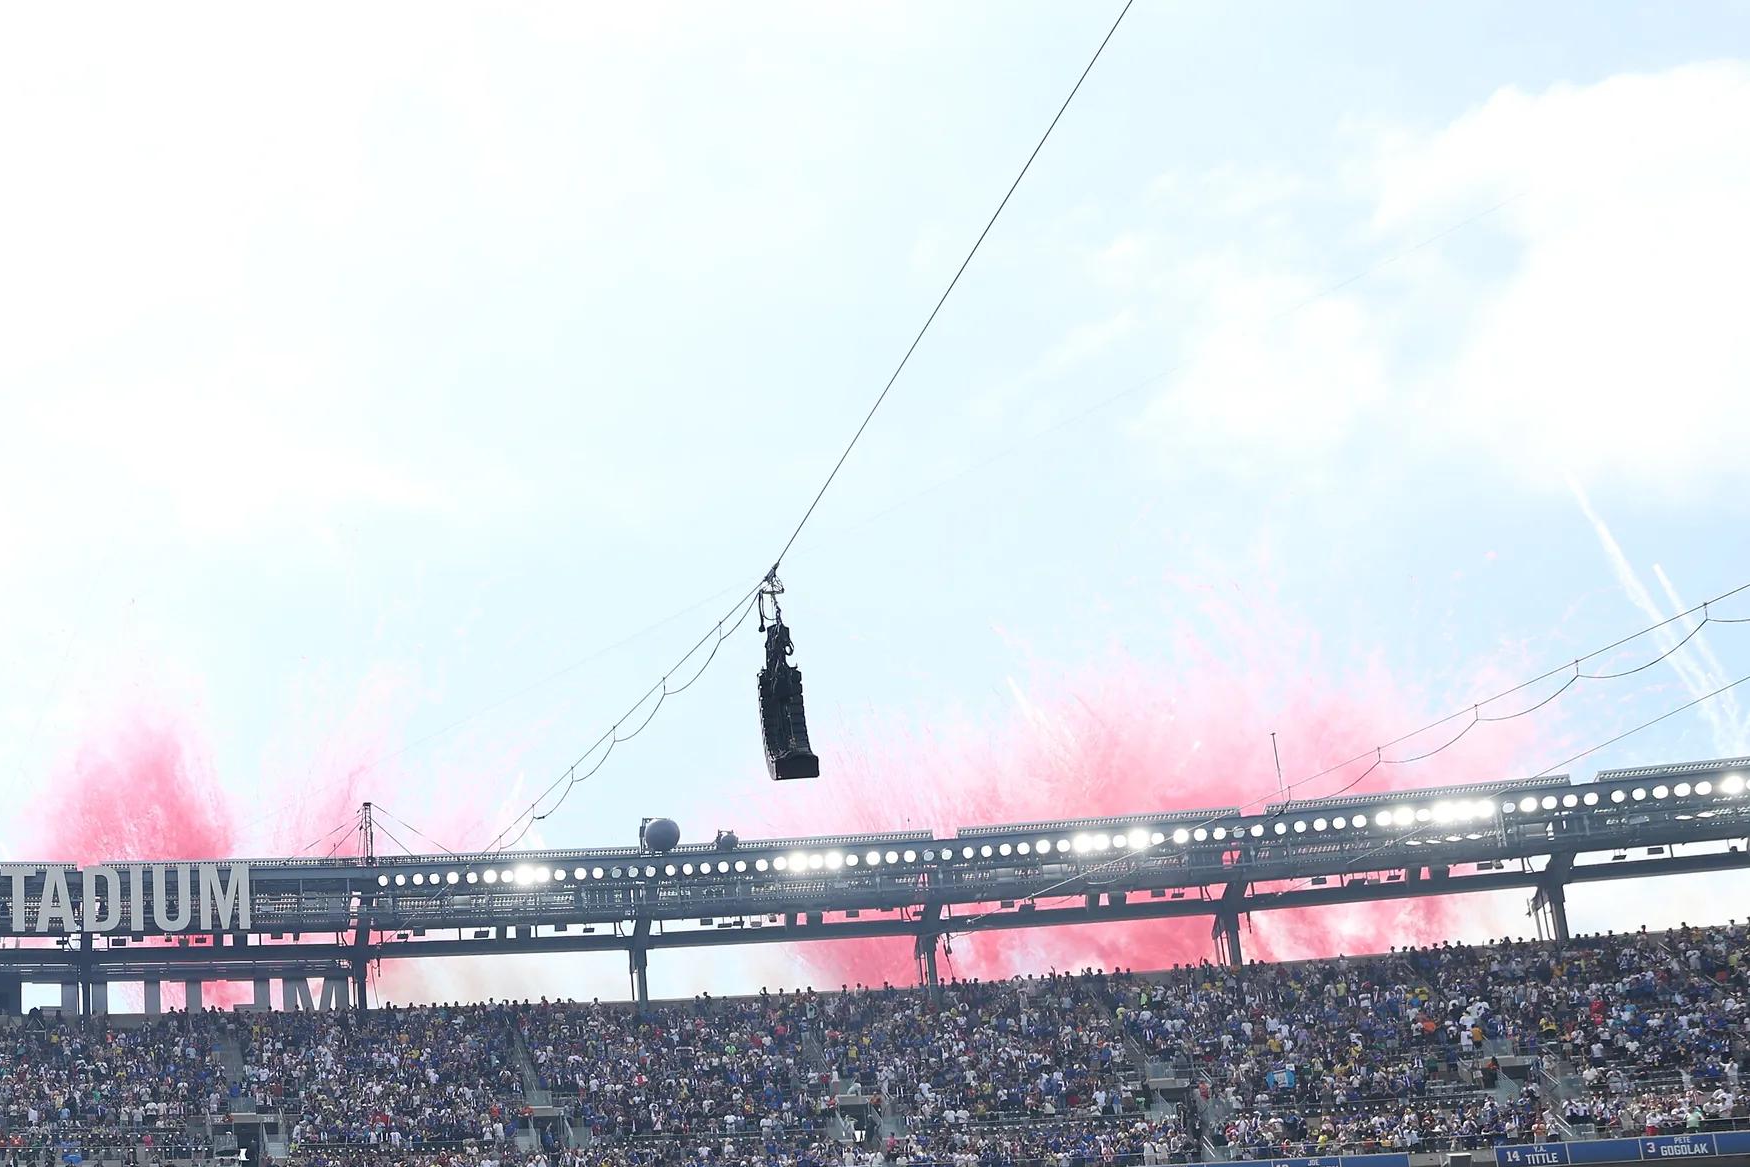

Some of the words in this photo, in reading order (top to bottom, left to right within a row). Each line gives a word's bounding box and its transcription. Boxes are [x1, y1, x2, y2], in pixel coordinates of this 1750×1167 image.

[1673, 1136, 1690, 1145] PETE
[1646, 1142, 1656, 1153] 3
[1660, 1143, 1708, 1156] GOGOLAK
[1506, 1152, 1520, 1162] 14
[1525, 1152, 1559, 1164] TITTLE
